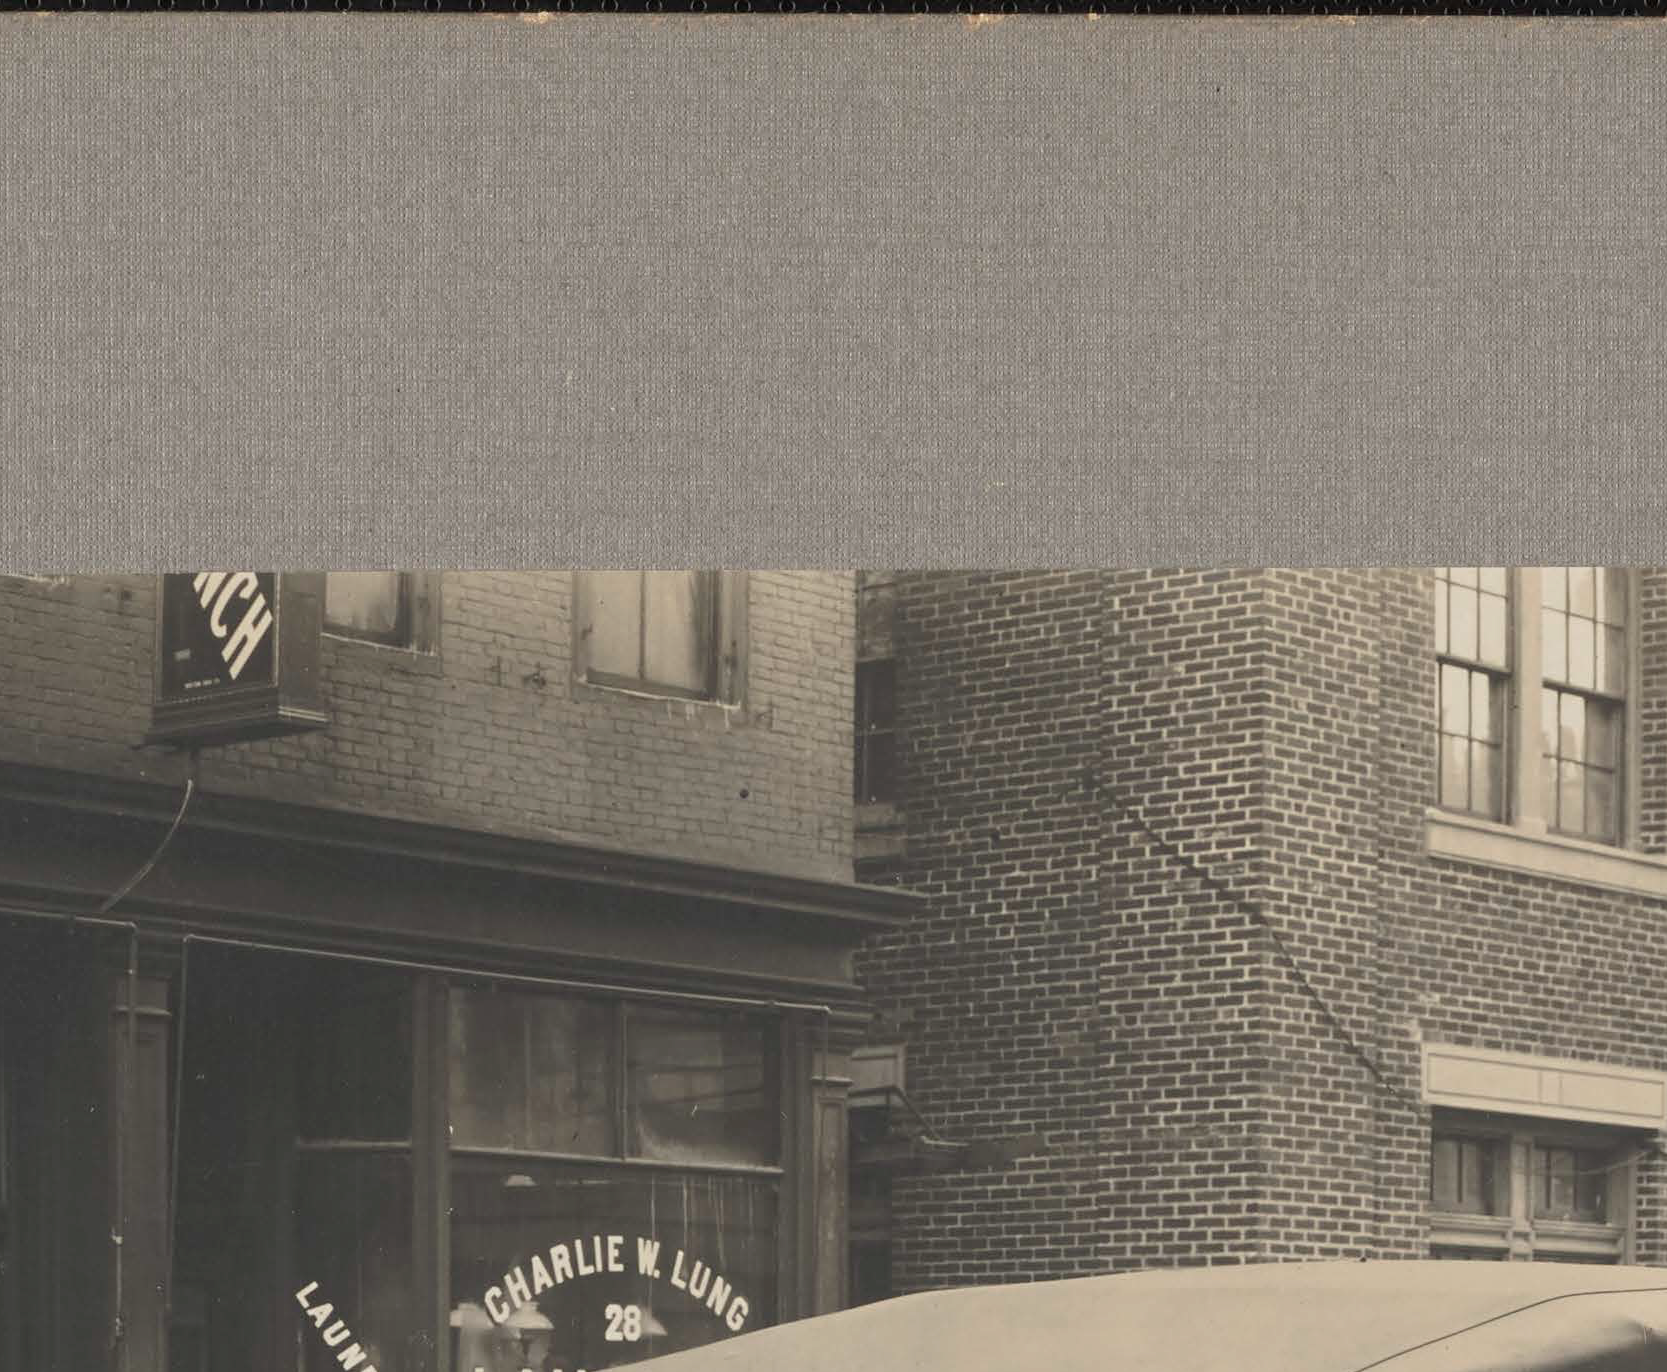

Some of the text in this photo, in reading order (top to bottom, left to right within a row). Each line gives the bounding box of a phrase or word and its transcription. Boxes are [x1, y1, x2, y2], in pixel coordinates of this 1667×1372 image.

[484, 1235, 750, 1331] CHARLIE W. LUNG
[604, 1303, 642, 1342] 28
